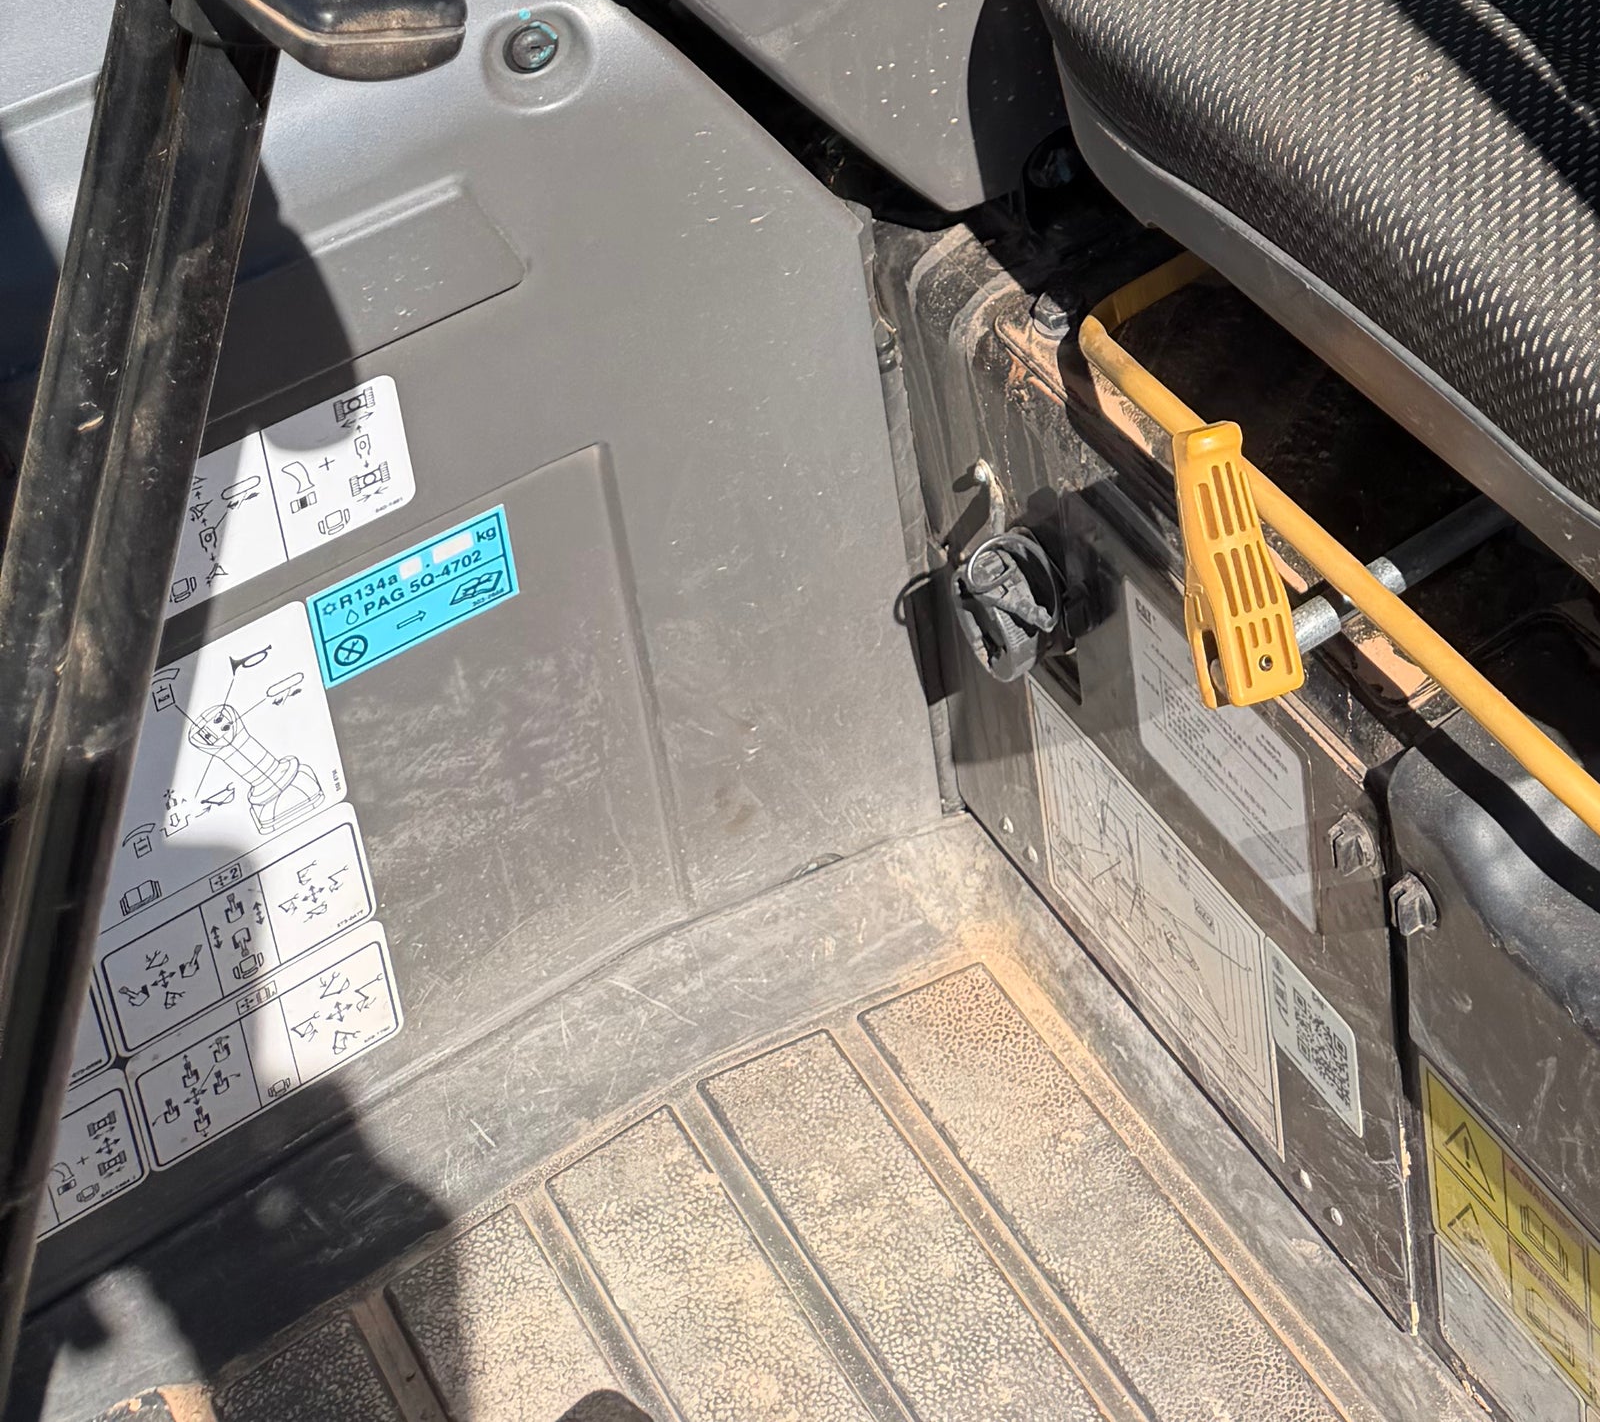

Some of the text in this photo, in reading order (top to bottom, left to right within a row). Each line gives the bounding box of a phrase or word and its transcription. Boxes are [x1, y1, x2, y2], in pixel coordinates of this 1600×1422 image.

[339, 526, 496, 609] R134a kg
[364, 588, 405, 617] PAG
